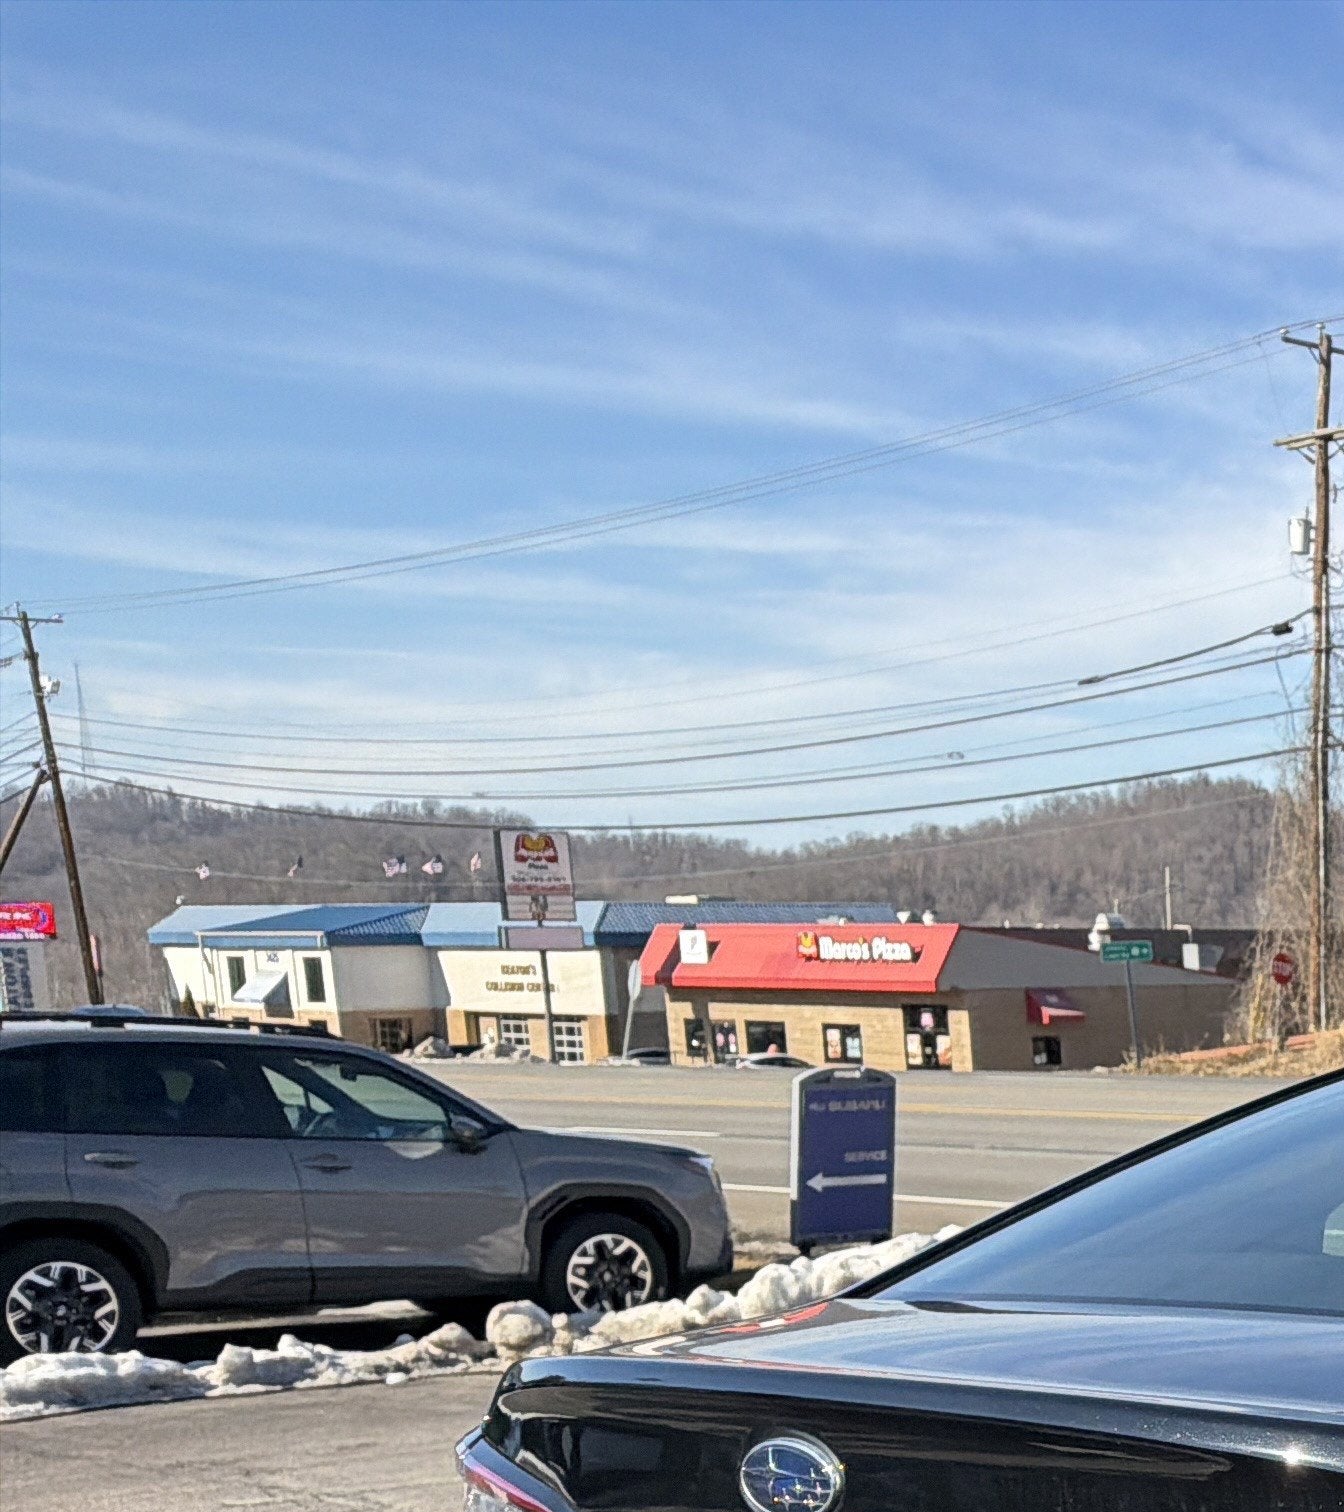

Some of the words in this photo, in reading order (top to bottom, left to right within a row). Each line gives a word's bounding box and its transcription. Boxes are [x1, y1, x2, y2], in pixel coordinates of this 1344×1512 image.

[818, 936, 870, 960] Marco's
[871, 936, 912, 961] Pizza
[1272, 960, 1292, 976] STOP
[828, 1099, 886, 1112] SUBARU
[844, 1149, 888, 1163] SERVICE
